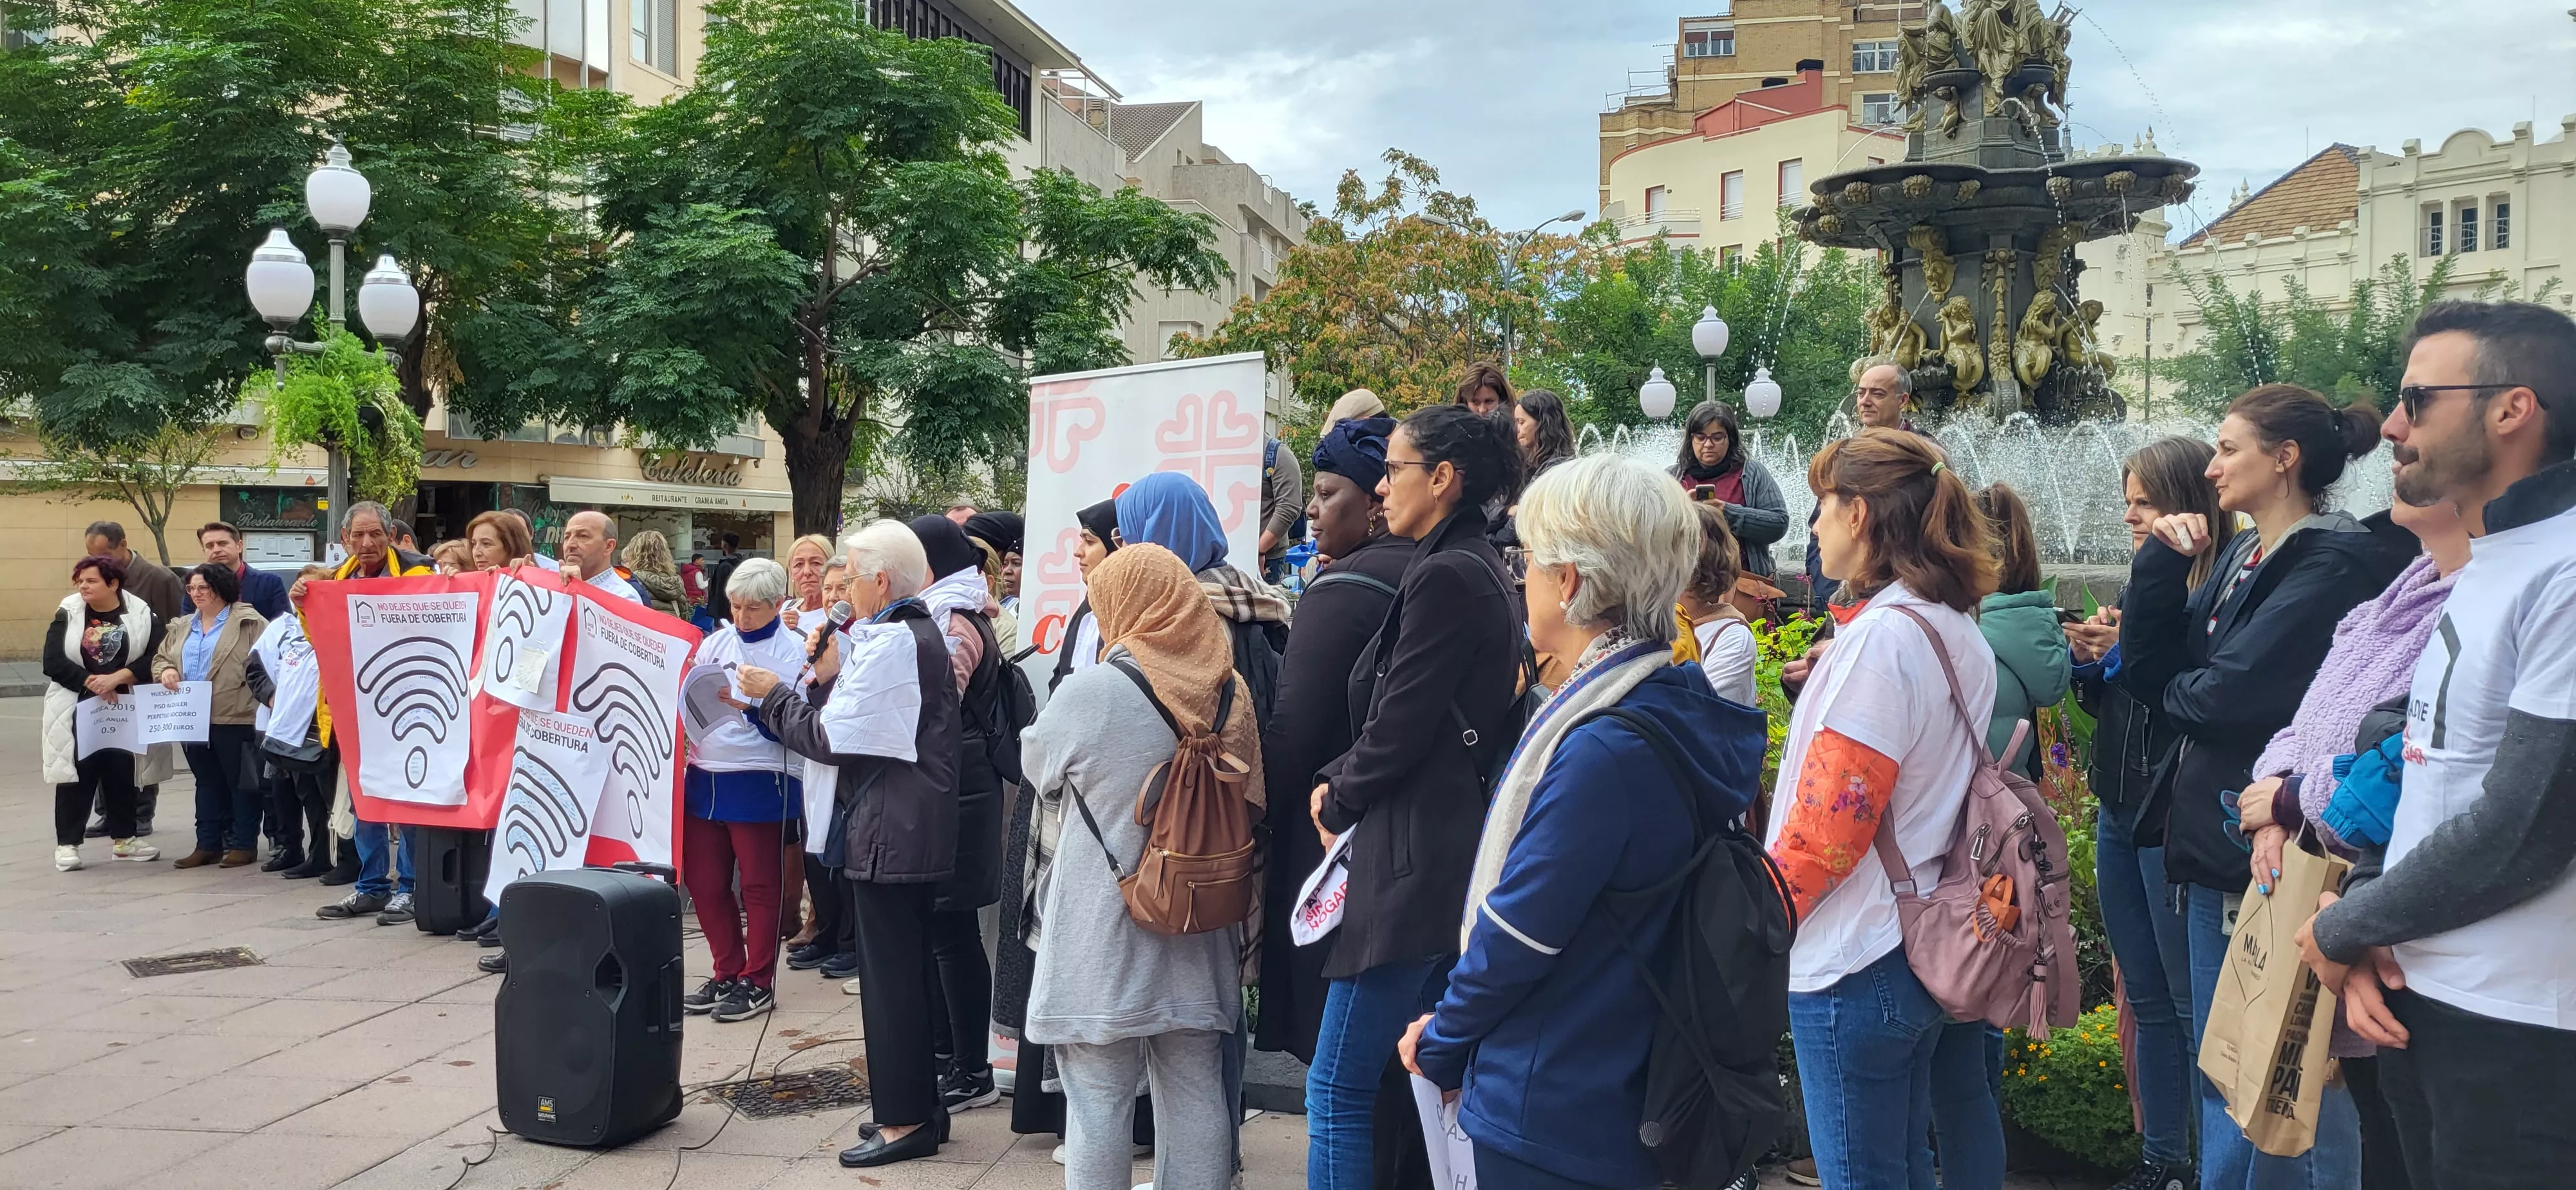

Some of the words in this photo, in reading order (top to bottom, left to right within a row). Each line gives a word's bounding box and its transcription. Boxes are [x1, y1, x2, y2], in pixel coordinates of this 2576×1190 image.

[421, 449, 477, 468] ar
[652, 494, 687, 504] RESTAURANTE
[236, 513, 318, 527] Restaurante
[377, 602, 388, 611] NO
[390, 601, 412, 611] DEJES
[413, 602, 430, 611] QUE
[431, 601, 441, 610] SE
[443, 600, 467, 610] QUEDEN
[381, 613, 407, 623] FUERA
[408, 614, 421, 623] DE
[422, 612, 467, 623] COBERTURA
[607, 618, 623, 634] DEJES
[623, 626, 634, 640] QUE
[634, 632, 643, 643] SE
[643, 635, 667, 655] QUEDEN
[601, 627, 619, 646] FUERA
[620, 638, 628, 650] DE
[629, 641, 665, 671] COBERTURA
[90, 706, 109, 715] HUESCA
[110, 703, 135, 712] 2019
[2409, 699, 2429, 722] ADIE
[540, 717, 552, 729] SE
[553, 721, 594, 739] QUEDEN
[529, 726, 589, 753] COBERTURA
[1305, 898, 1323, 921] SIN
[540, 1098, 554, 1108] AMS
